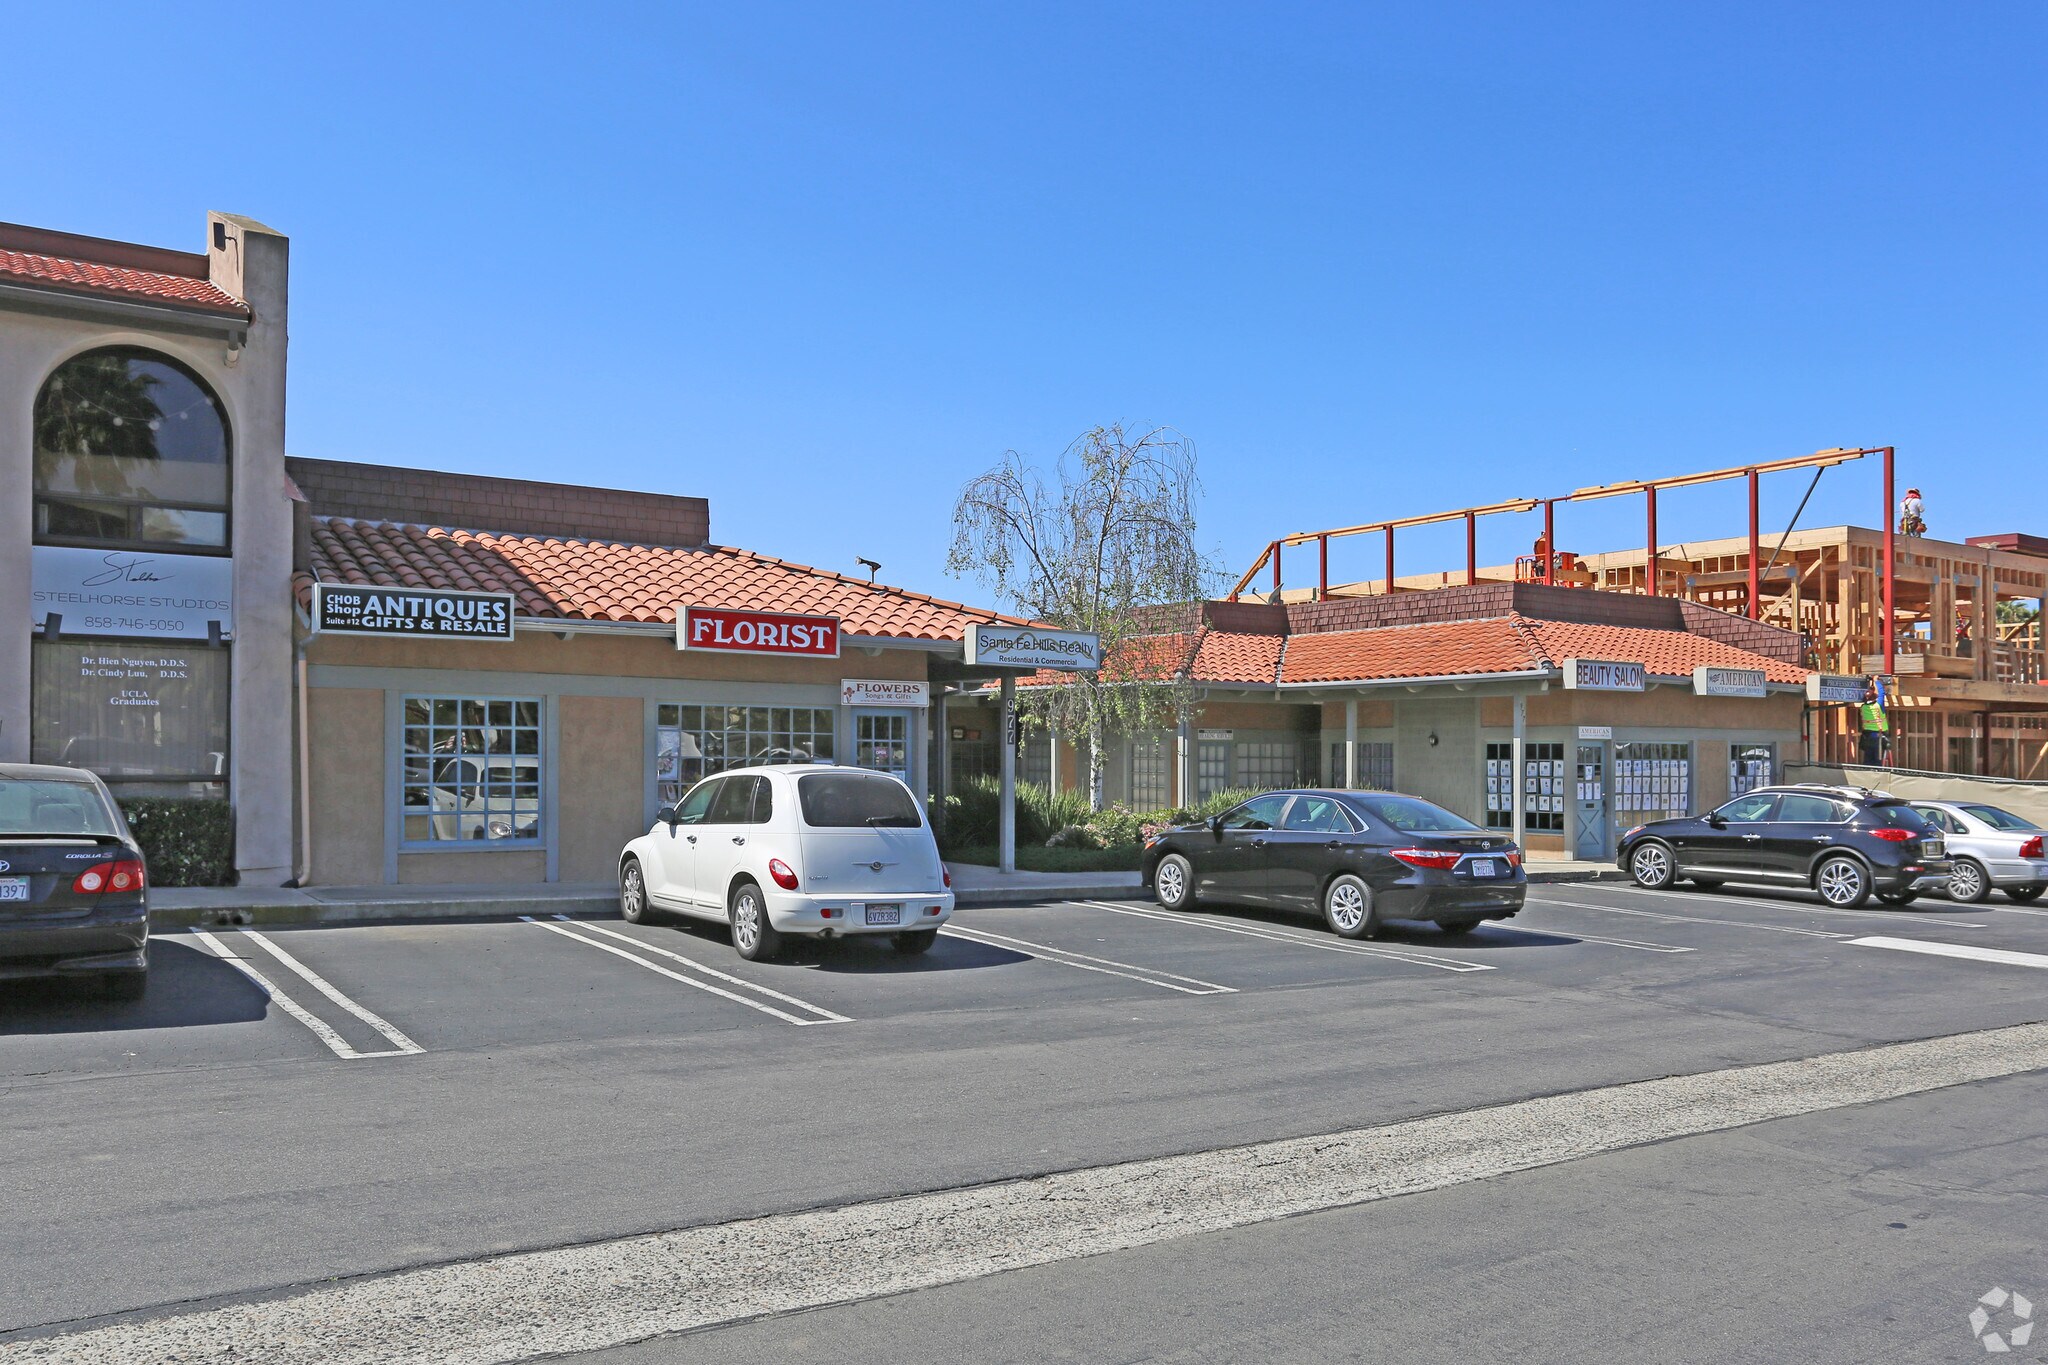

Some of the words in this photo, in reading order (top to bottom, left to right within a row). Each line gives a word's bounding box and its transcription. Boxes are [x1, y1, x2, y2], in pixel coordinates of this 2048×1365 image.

[33, 591, 145, 607] STEELHORSE
[150, 597, 229, 610] STUDIOS
[326, 594, 361, 605] CHOB
[326, 603, 361, 616] Shop
[363, 595, 506, 622] ANTIQUES
[84, 617, 185, 632] 858-746-5050
[326, 617, 345, 625] Suite
[361, 616, 415, 629] GIFTS
[420, 619, 435, 630] &
[440, 620, 507, 633] RESALE
[693, 618, 832, 648] FLORIST
[980, 635, 1013, 649] Santa
[1059, 640, 1094, 656] Realty
[82, 656, 96, 665] Dr.
[98, 657, 119, 665] Hien
[122, 658, 158, 667] Nguyen,
[160, 659, 188, 667] D.D.S.
[999, 655, 1034, 664] Residential
[1041, 657, 1077, 666] Commercial
[82, 668, 96, 676] Dr.
[98, 669, 125, 678] Cindy
[160, 670, 188, 678] D.D.S.
[1577, 664, 1611, 686] BEAUTY
[1614, 666, 1643, 688] SALON
[1720, 672, 1763, 687] AMERICAN
[121, 690, 149, 698] UCLA
[856, 683, 920, 693] FLOWERS
[110, 696, 160, 706] Graduates
